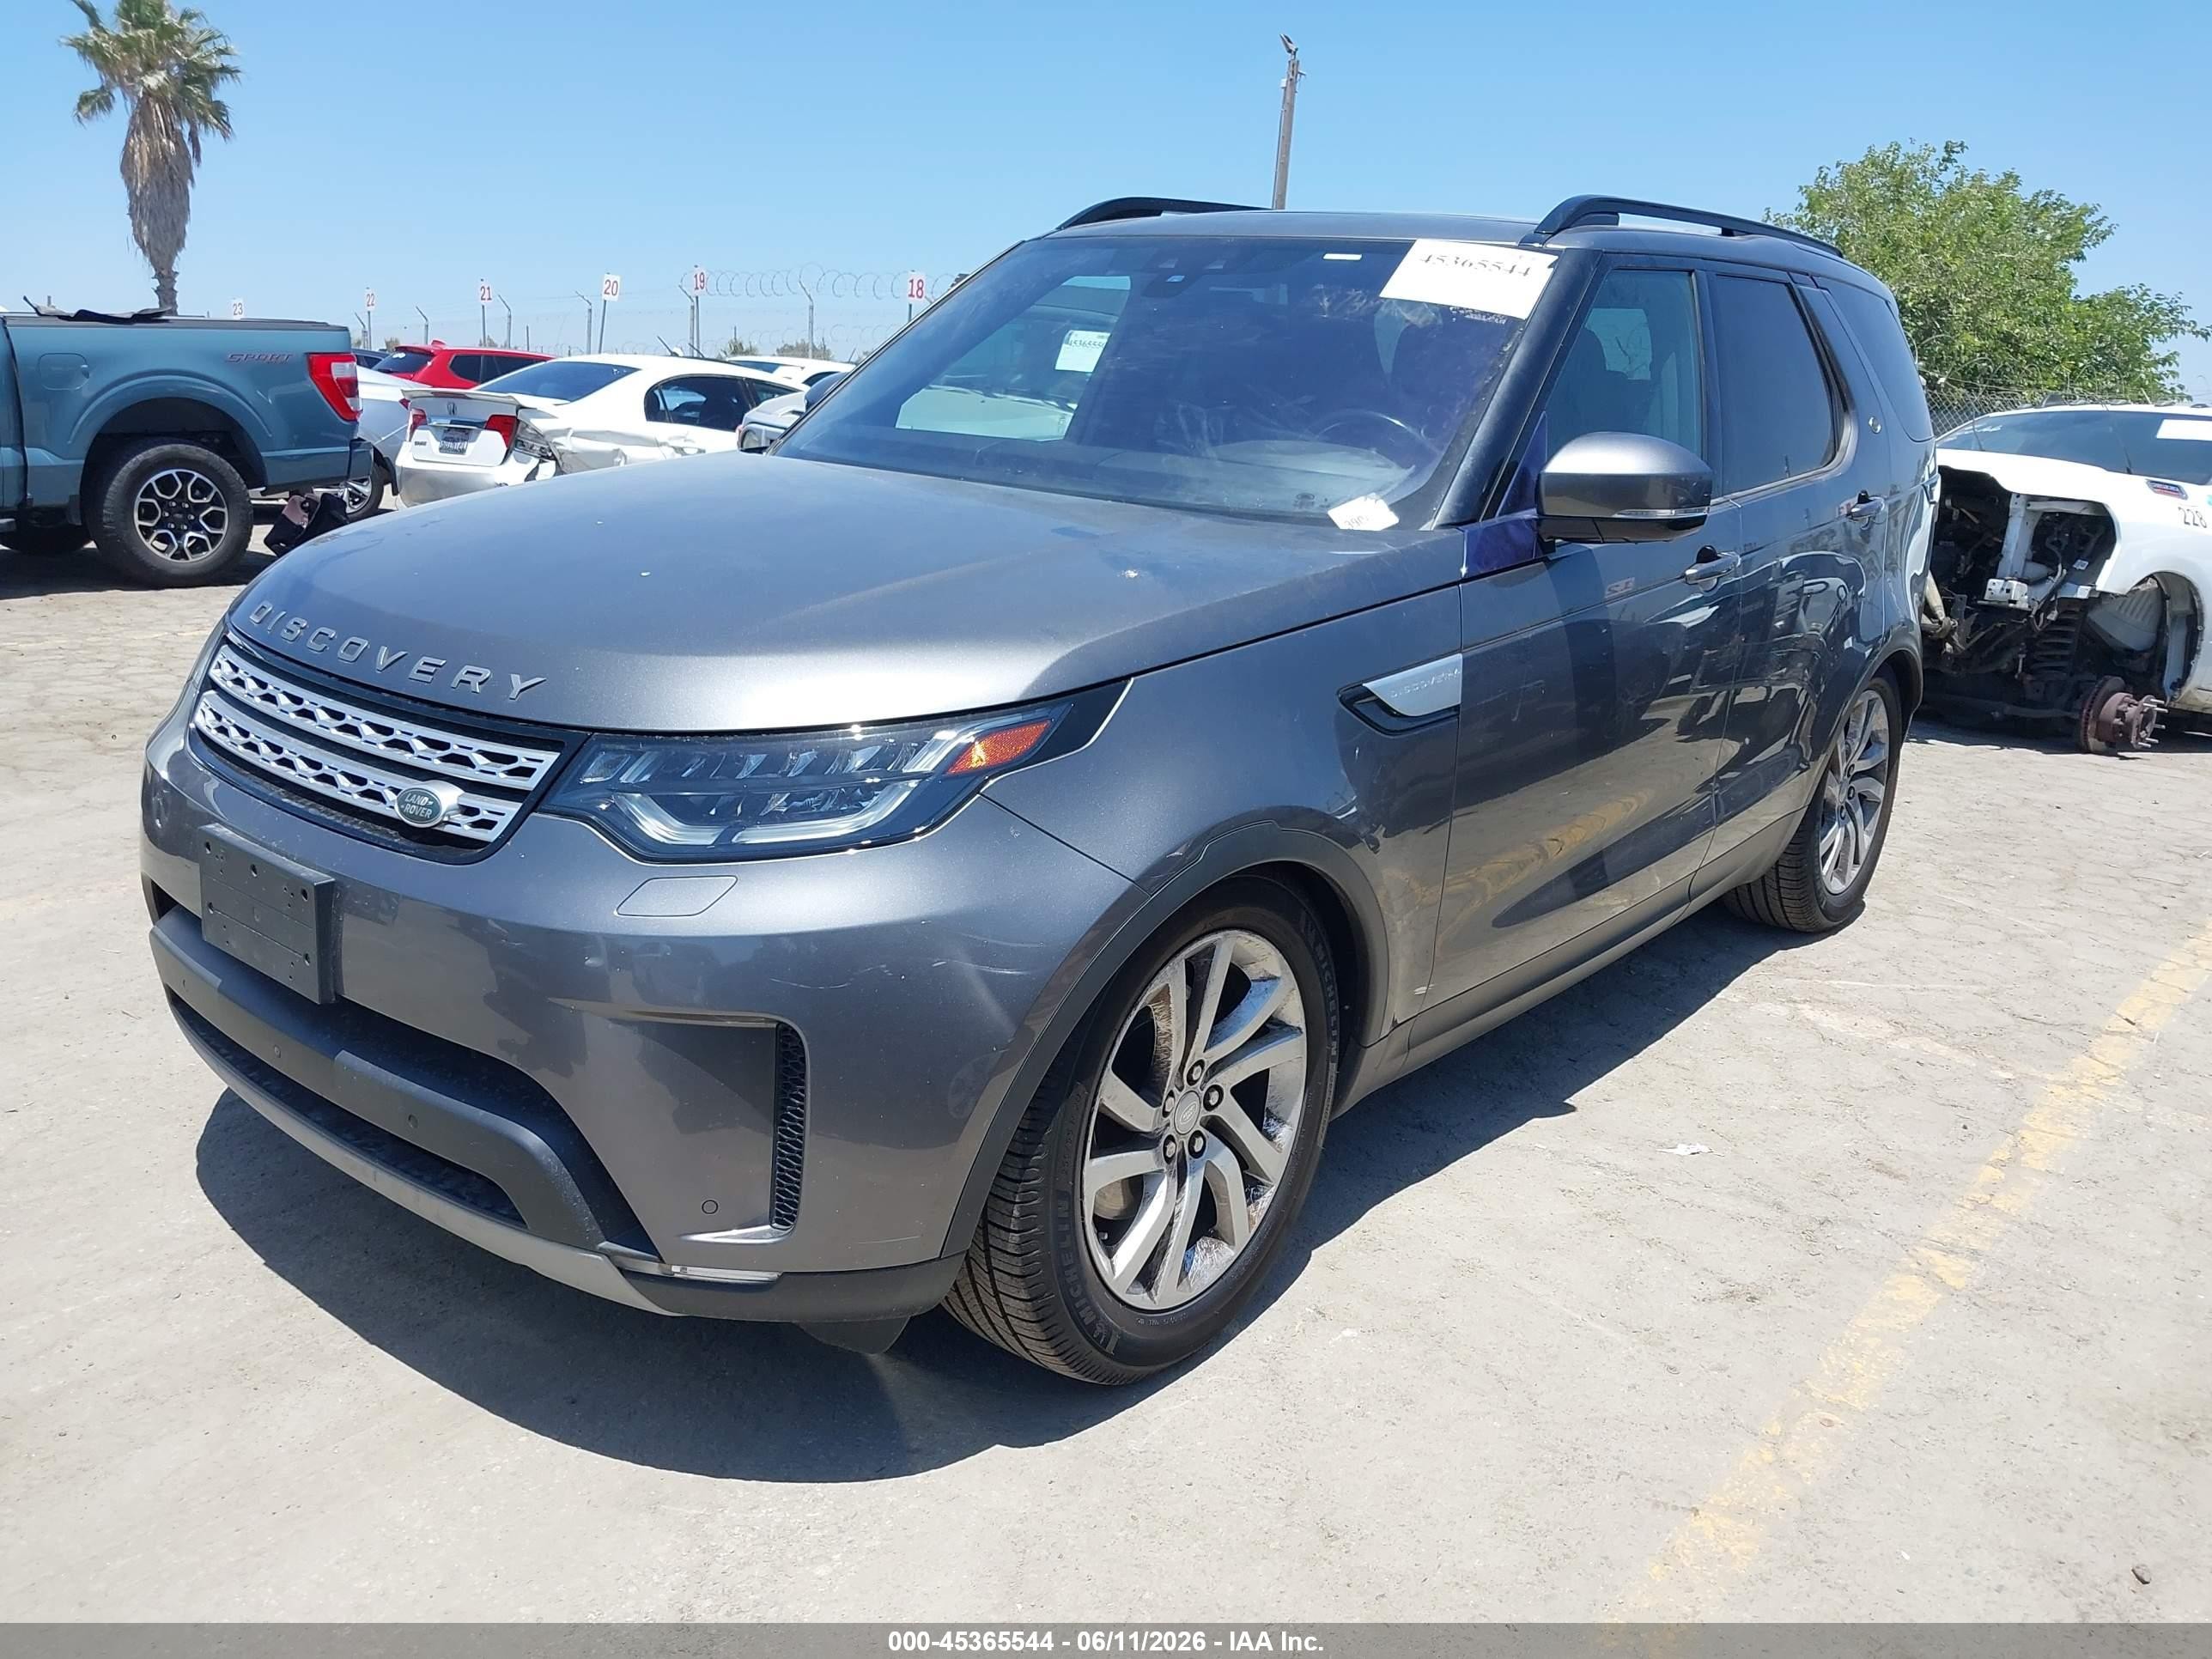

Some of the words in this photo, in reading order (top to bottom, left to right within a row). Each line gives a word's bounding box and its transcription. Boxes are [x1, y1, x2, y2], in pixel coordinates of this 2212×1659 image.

[604, 279, 618, 296] 20
[694, 272, 705, 290] 19
[908, 278, 924, 299] 18
[366, 293, 375, 307] 22
[479, 285, 492, 301] 21
[233, 302, 243, 316] 23
[224, 352, 294, 366] SPORT
[2178, 507, 2207, 529] 228
[248, 600, 548, 702] DISCOVERY
[404, 793, 429, 806] LAND
[404, 803, 433, 818] ROVER
